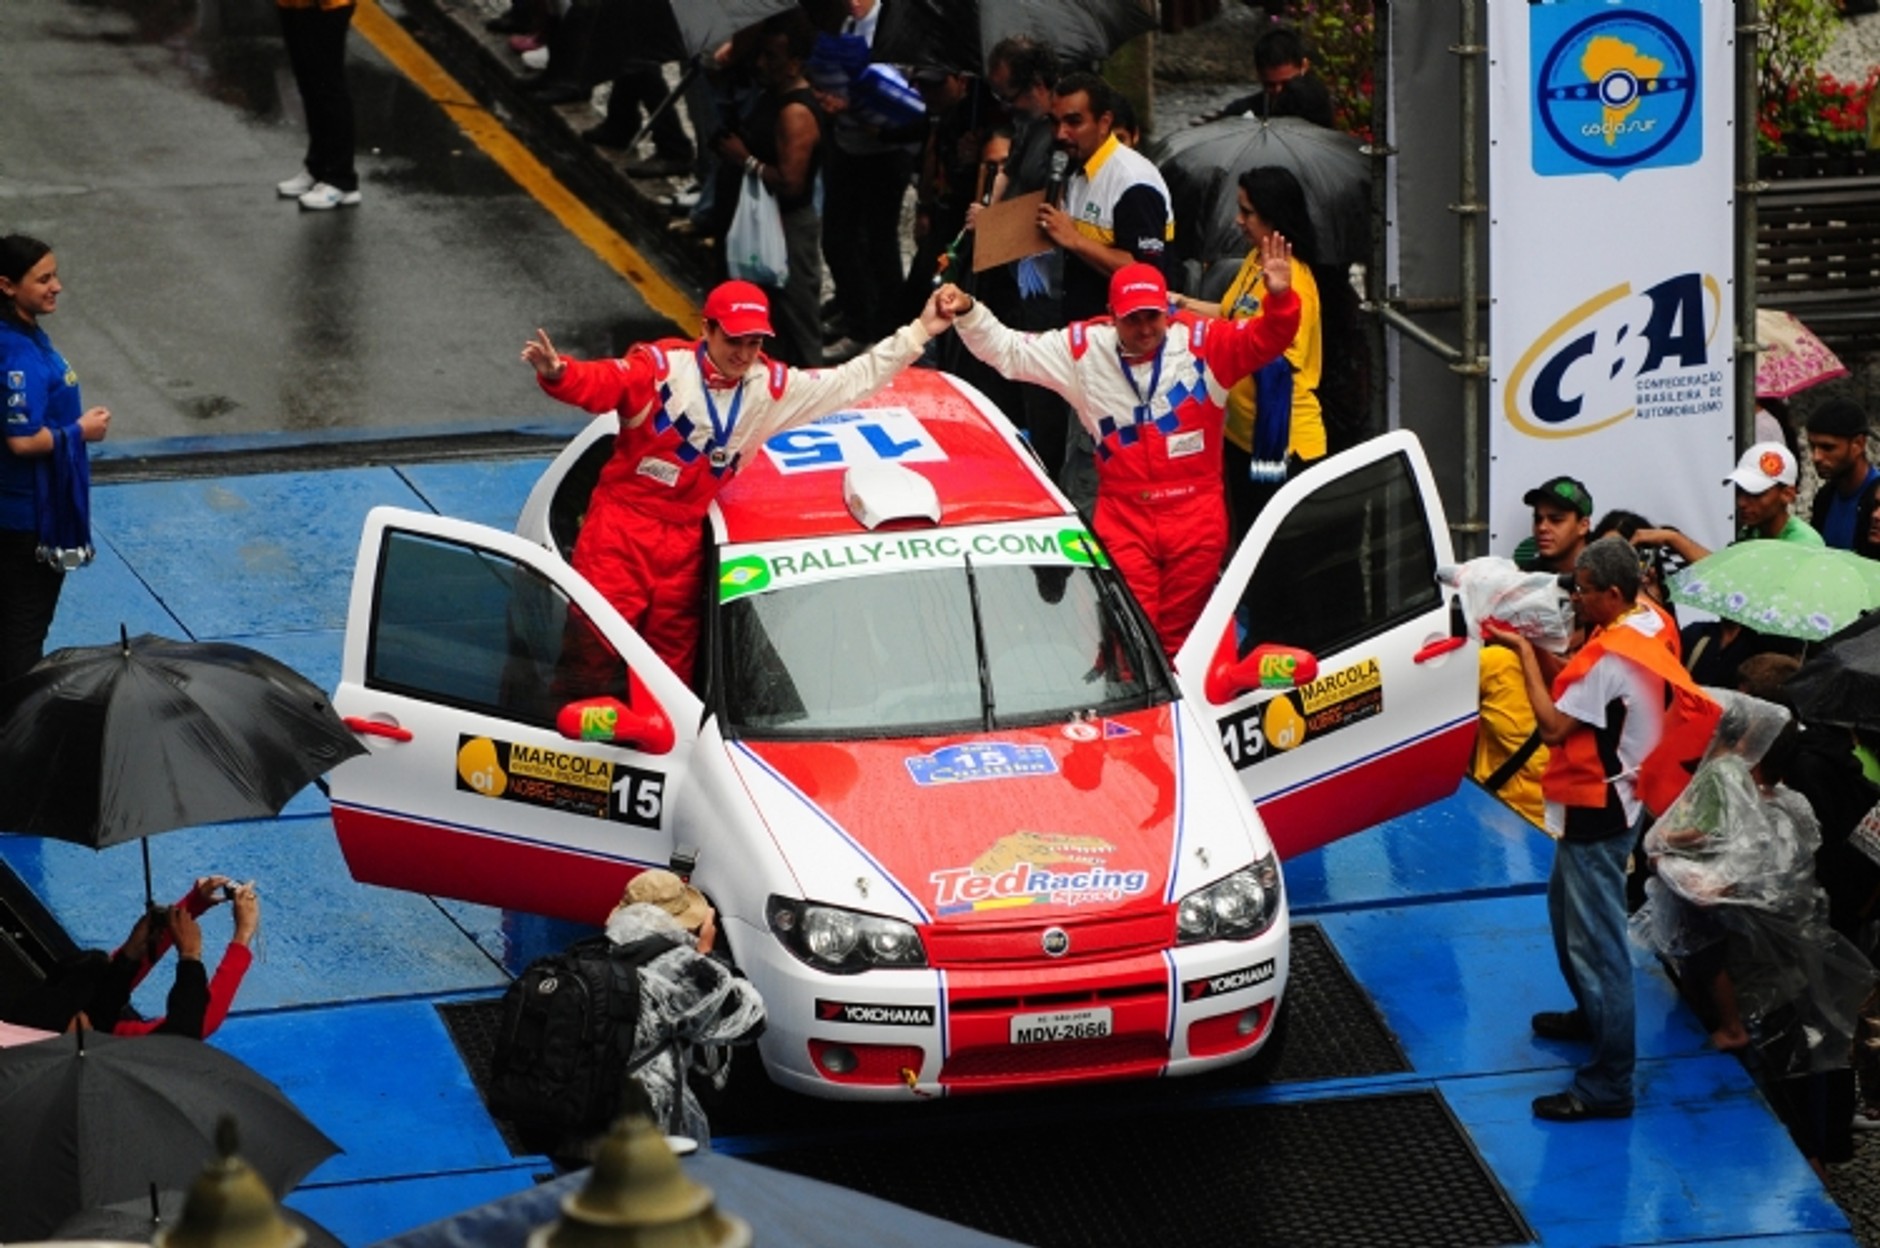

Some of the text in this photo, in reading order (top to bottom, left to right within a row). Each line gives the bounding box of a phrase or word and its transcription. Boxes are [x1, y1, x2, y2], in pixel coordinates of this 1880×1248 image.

[1530, 273, 1708, 424] CBA
[1635, 401, 1723, 418] AUTOMOBILISMO
[1636, 386, 1722, 405] BRASILEIRA DE
[770, 533, 1058, 578] RALLY-IRCCOM
[1301, 659, 1379, 701] MARCOLA
[1222, 716, 1265, 763] 15
[1277, 719, 1296, 747] oi
[511, 744, 610, 778] MARCOLA
[953, 751, 1007, 768] 15
[471, 766, 494, 790] oi
[611, 774, 662, 818] 15
[844, 1005, 931, 1023] YOKOHAMA
